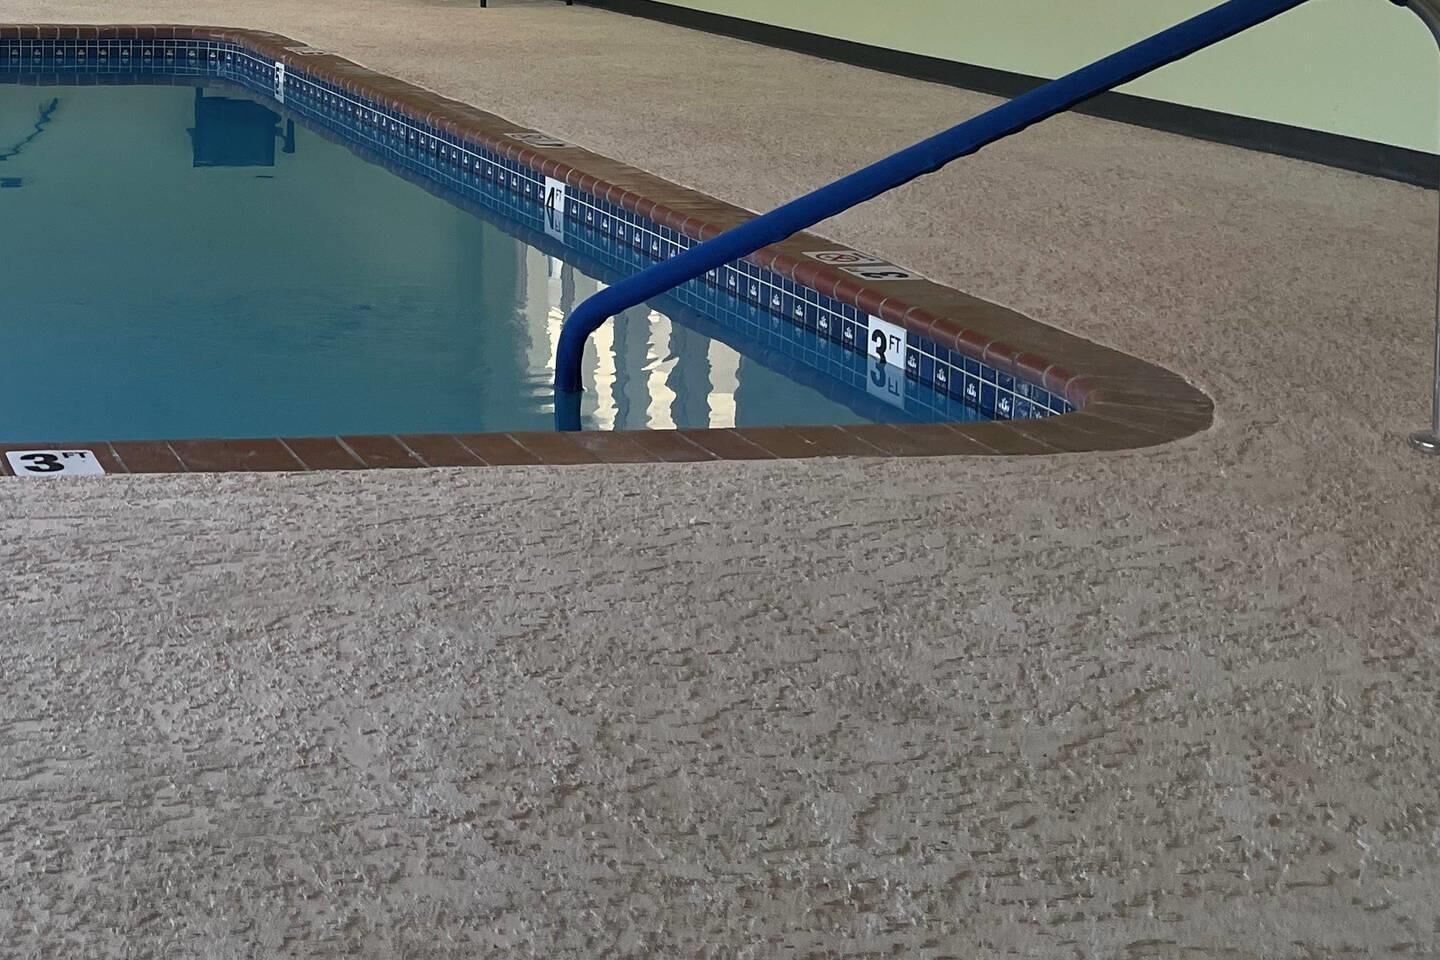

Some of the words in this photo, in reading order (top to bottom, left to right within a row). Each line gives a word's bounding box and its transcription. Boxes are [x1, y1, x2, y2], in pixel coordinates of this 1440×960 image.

[546, 187, 555, 209] 4
[871, 329, 887, 363] 3
[889, 334, 901, 353] FT
[20, 453, 65, 472] 3
